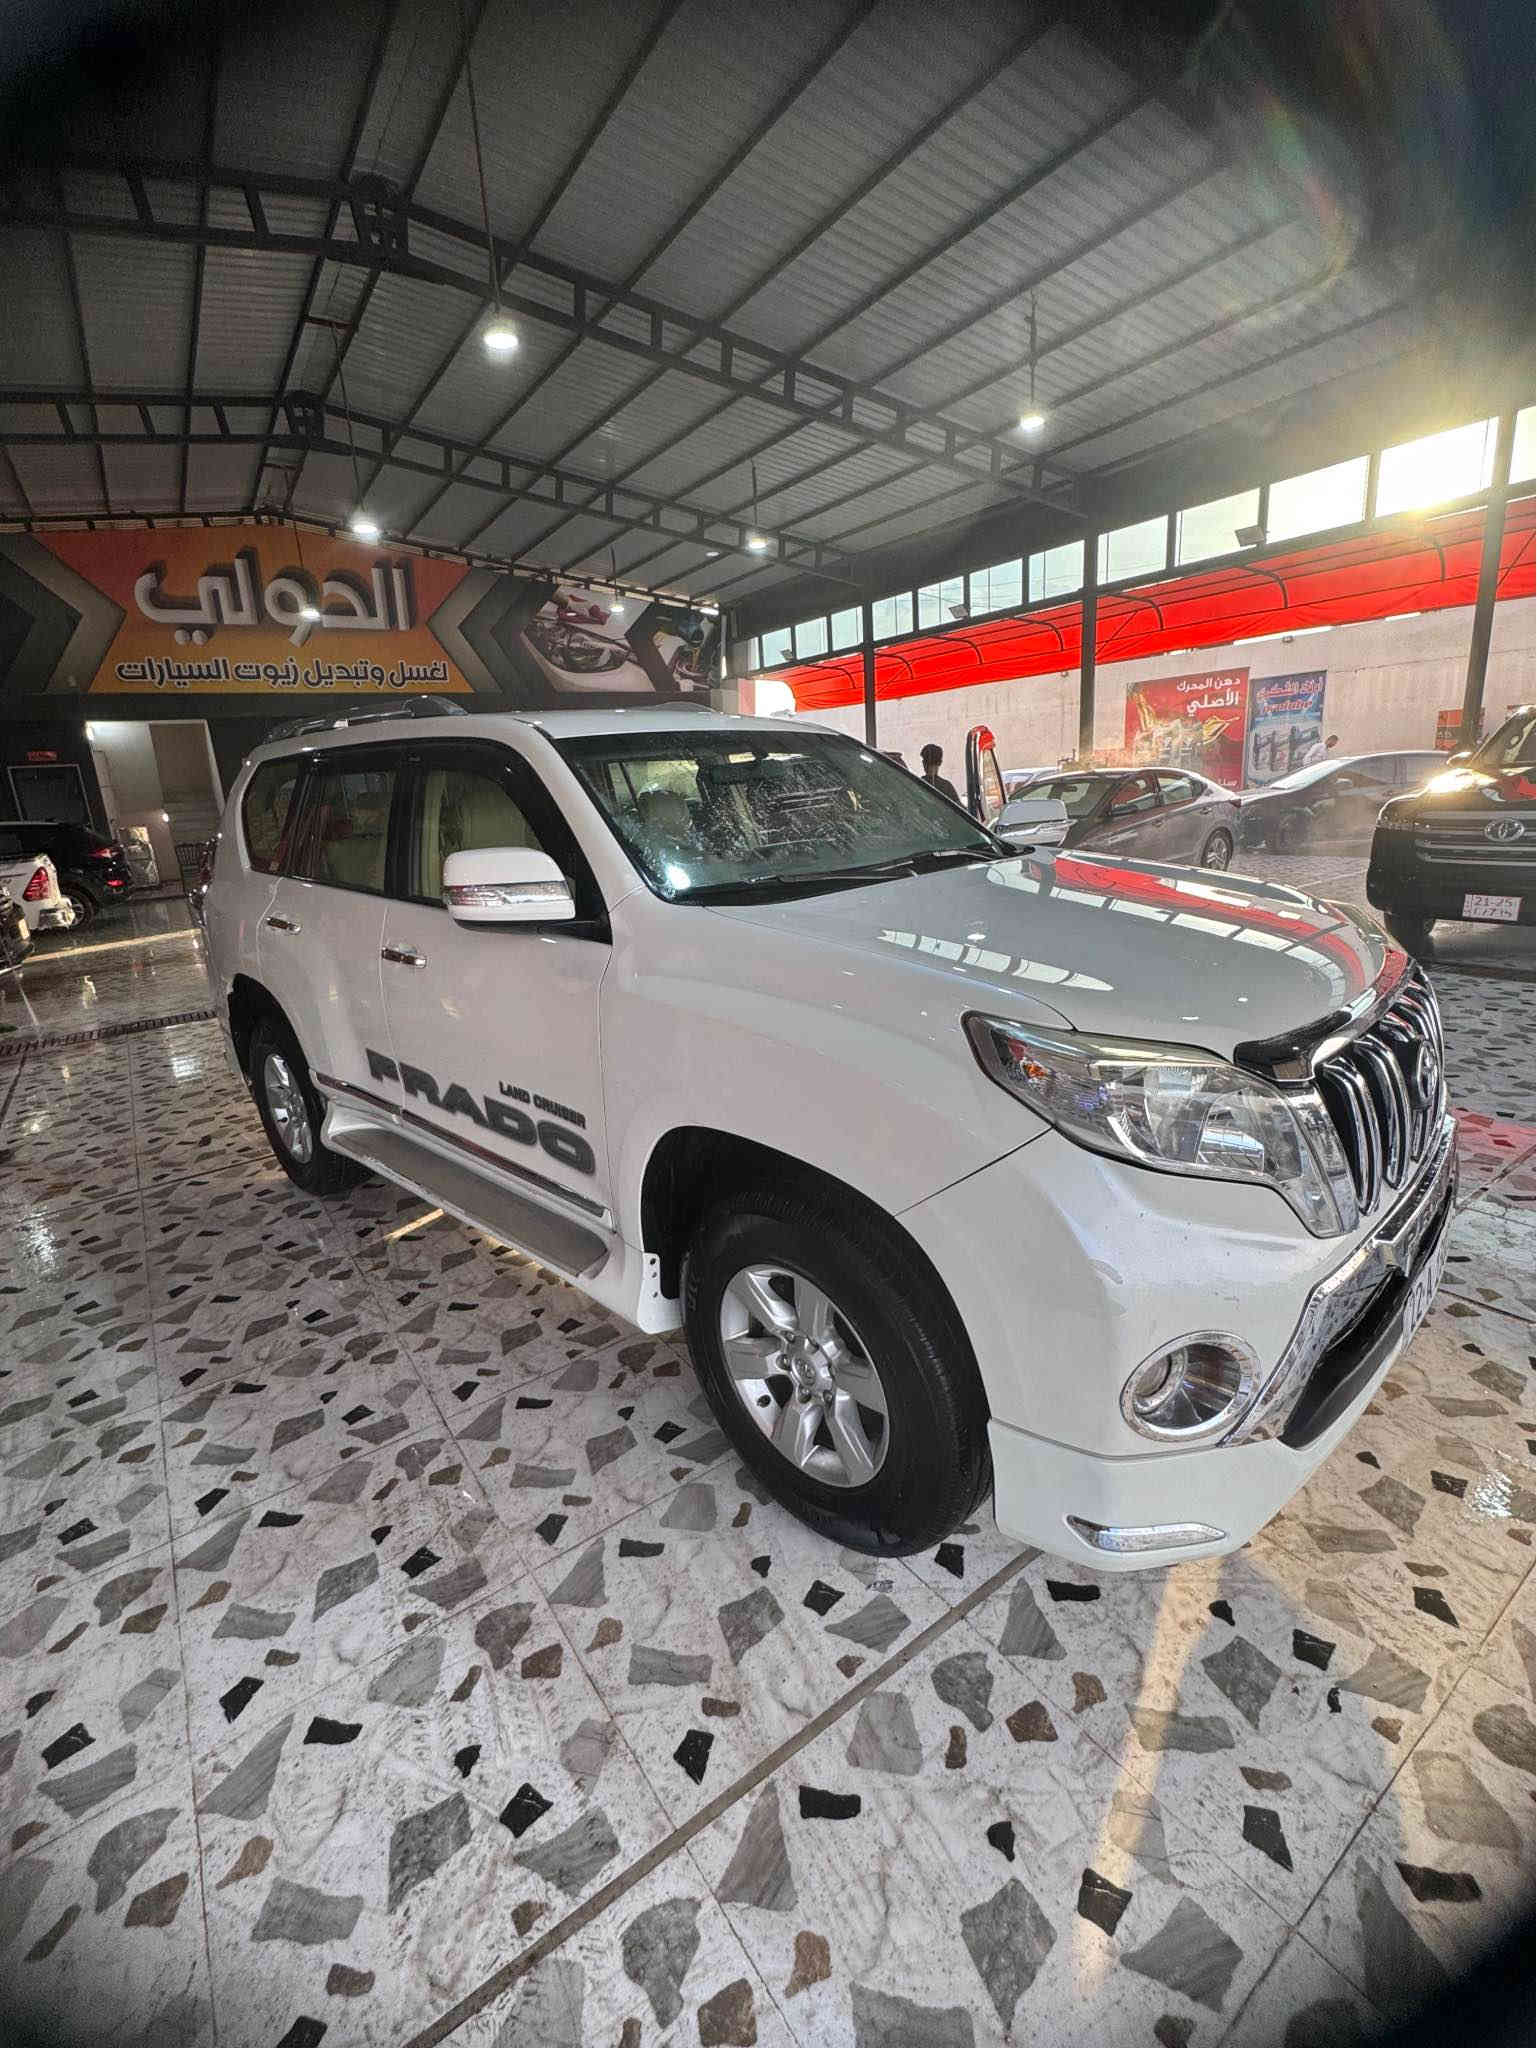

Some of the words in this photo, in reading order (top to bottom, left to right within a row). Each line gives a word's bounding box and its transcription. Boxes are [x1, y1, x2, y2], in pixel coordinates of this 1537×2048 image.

[134, 557, 410, 648] الحولي
[116, 657, 230, 688] السيارات
[233, 657, 300, 688] زيوت
[303, 659, 386, 689] وتبديل
[389, 660, 449, 688] لغسل
[1176, 678, 1213, 693] المحرك
[1214, 677, 1240, 689] دهن
[1186, 688, 1240, 717] الأصلي
[365, 1047, 597, 1176] PRADO
